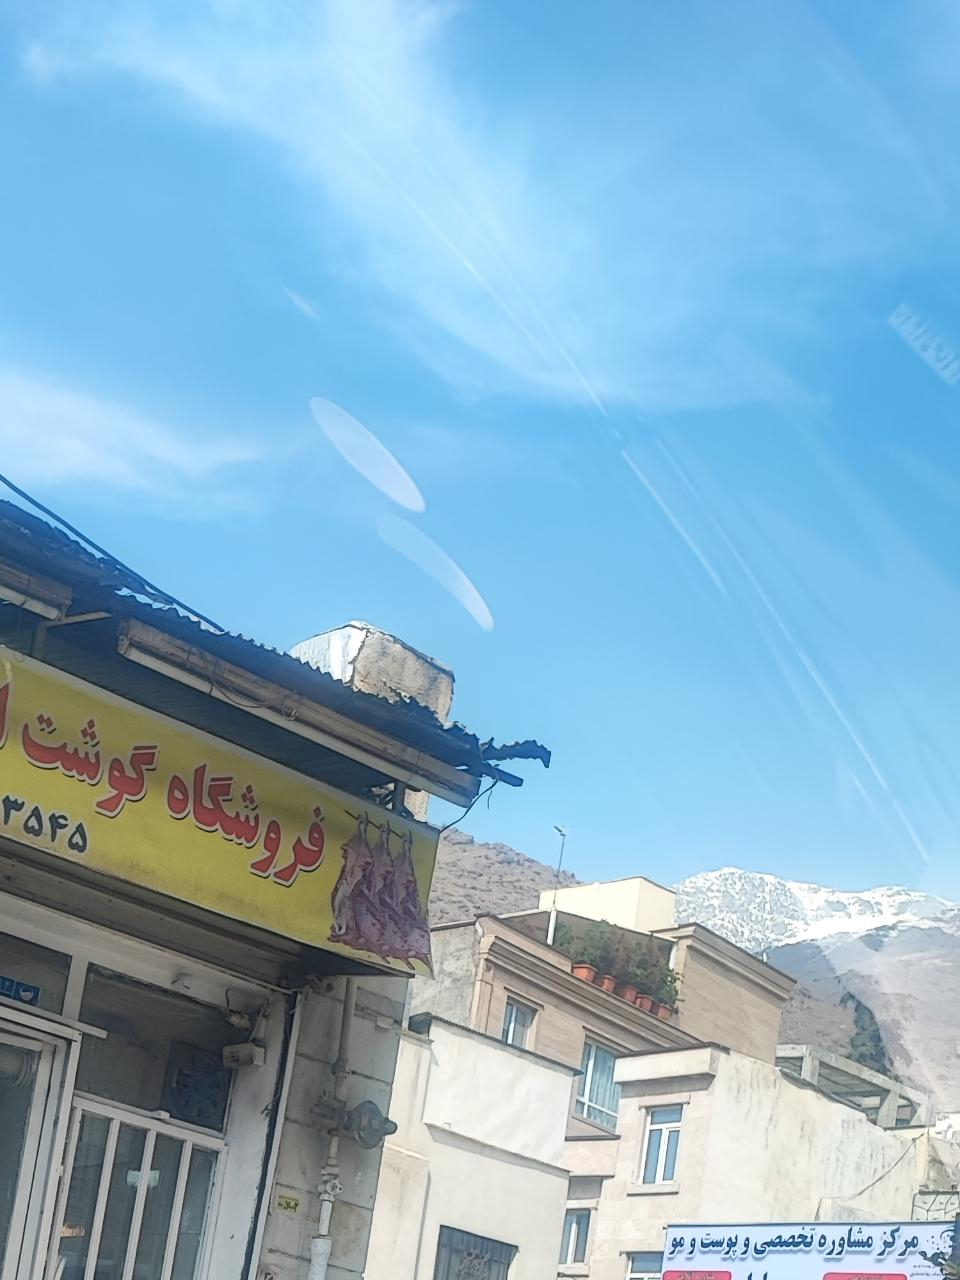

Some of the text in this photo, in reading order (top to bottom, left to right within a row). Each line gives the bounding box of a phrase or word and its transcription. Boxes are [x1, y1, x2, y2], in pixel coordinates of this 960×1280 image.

[22, 714, 158, 816] گوشت
[167, 764, 326, 885] فروشگاه
[669, 1225, 919, 1257] مرکز مشاوره تخصصی و پوست و مو
